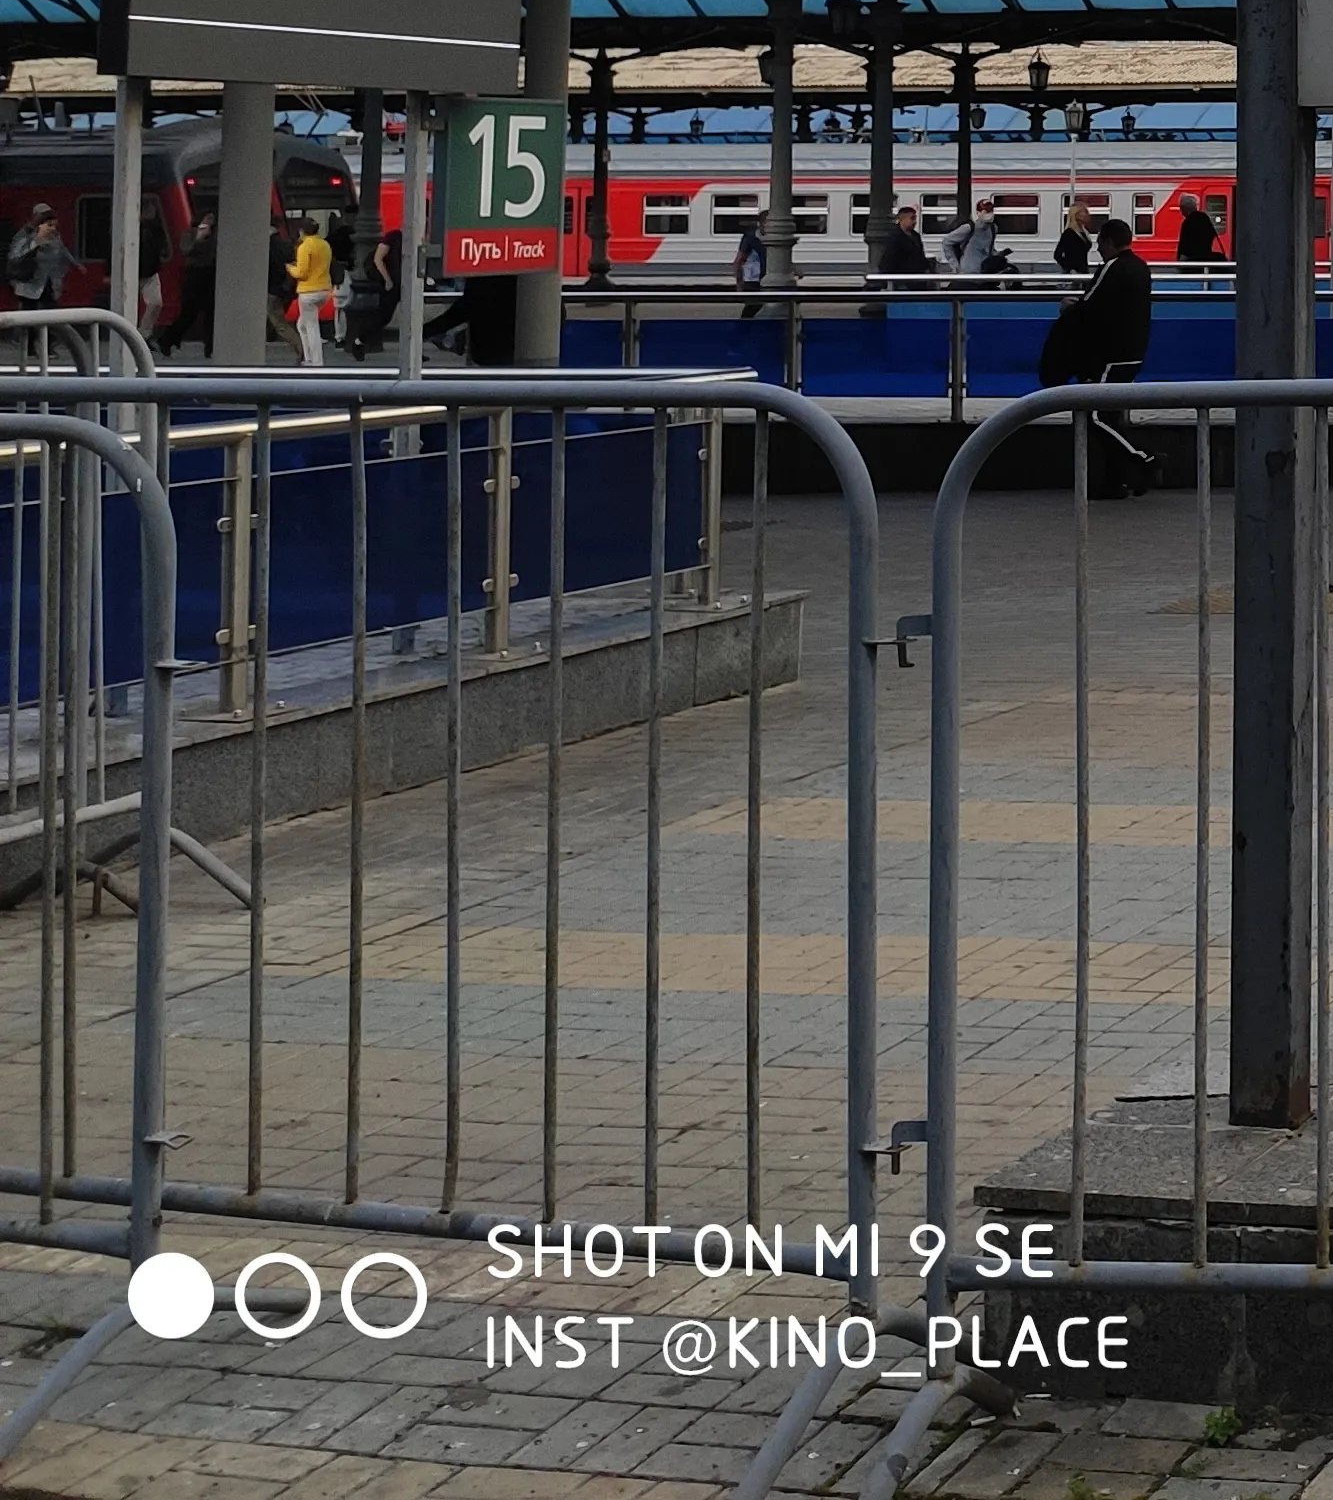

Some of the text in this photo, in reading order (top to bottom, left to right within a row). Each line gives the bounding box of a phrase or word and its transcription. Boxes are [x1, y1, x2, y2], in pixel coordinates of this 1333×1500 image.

[468, 114, 546, 218] 15
[461, 237, 546, 267] Путь Track
